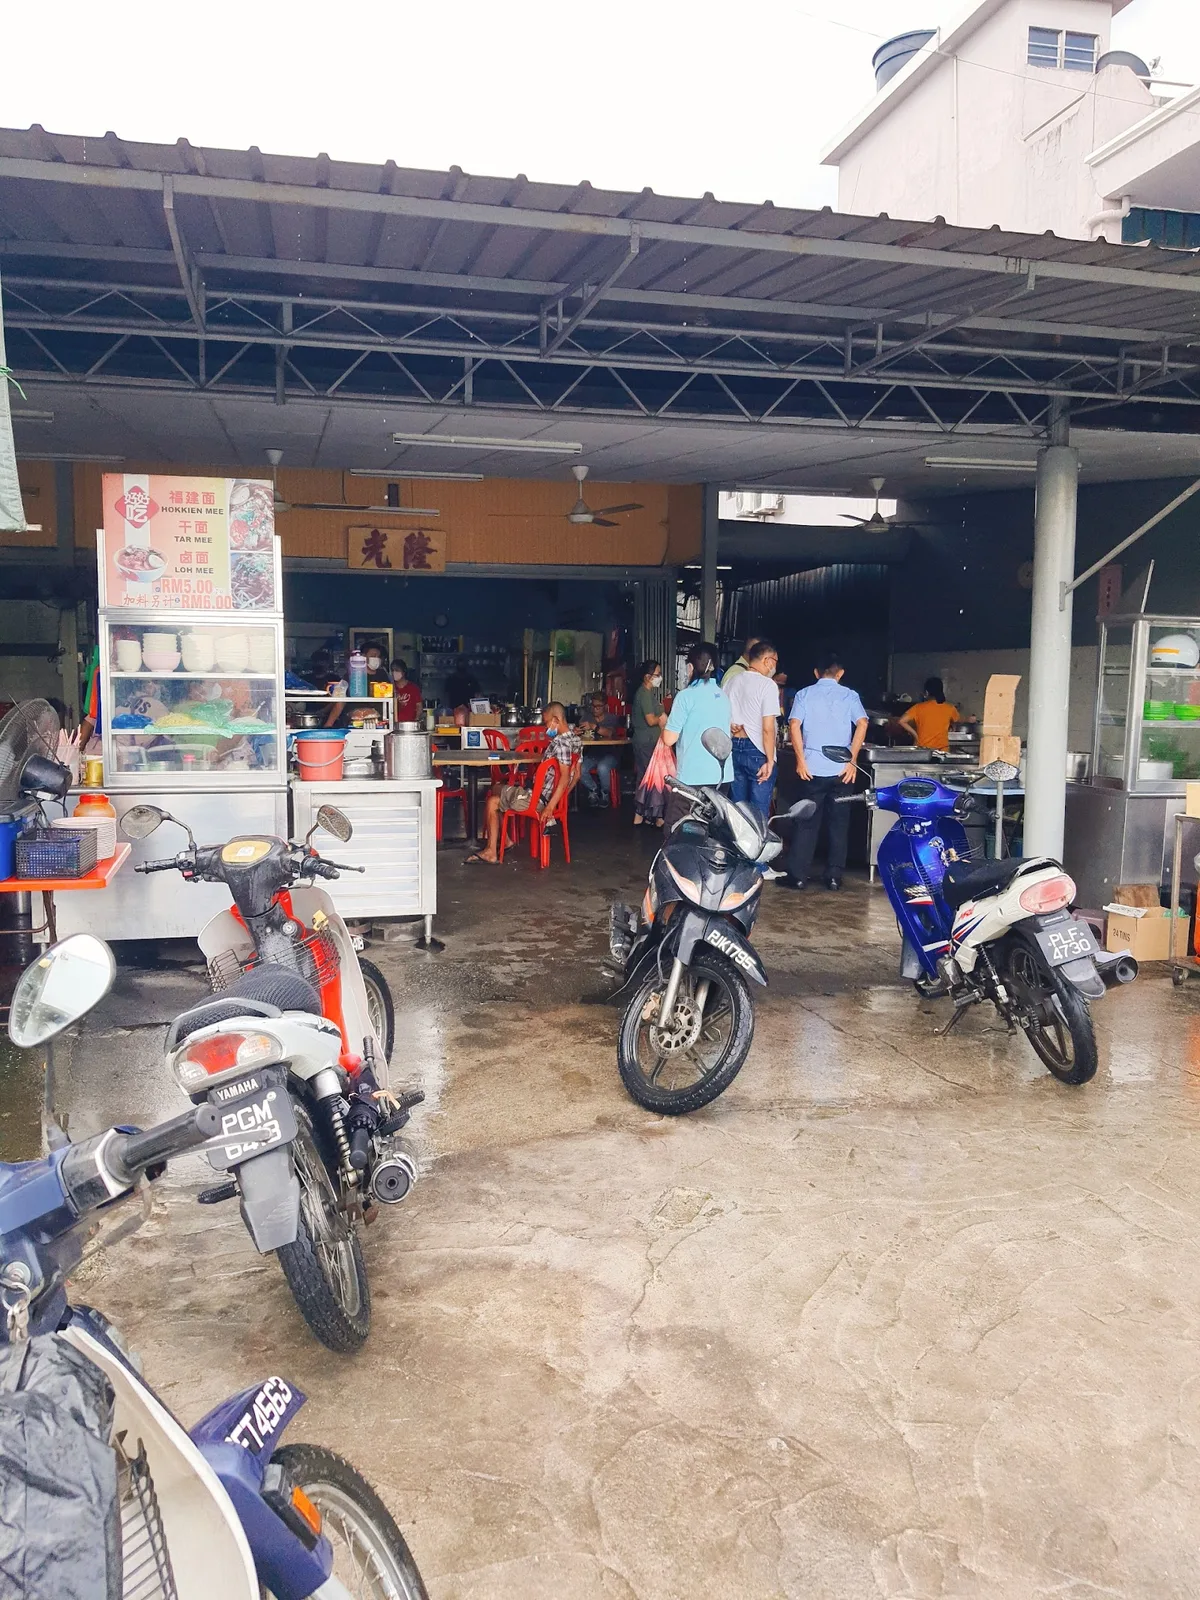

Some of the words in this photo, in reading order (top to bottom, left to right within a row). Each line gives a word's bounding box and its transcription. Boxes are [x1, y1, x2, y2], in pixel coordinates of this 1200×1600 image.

[169, 490, 215, 505] 福建面
[161, 506, 203, 514] HOKKIEN
[178, 520, 208, 534] 干面
[174, 535, 192, 543] TAR
[180, 551, 209, 564] 卤面
[161, 578, 213, 594] RM5.00
[181, 594, 232, 609] RM6.00
[1048, 927, 1079, 947] PLF
[706, 929, 757, 970] PJK1795
[1053, 938, 1091, 960] 4730
[216, 1078, 259, 1100] YAMAHA
[221, 1098, 273, 1136] PGM
[224, 1375, 293, 1449] FT4563
